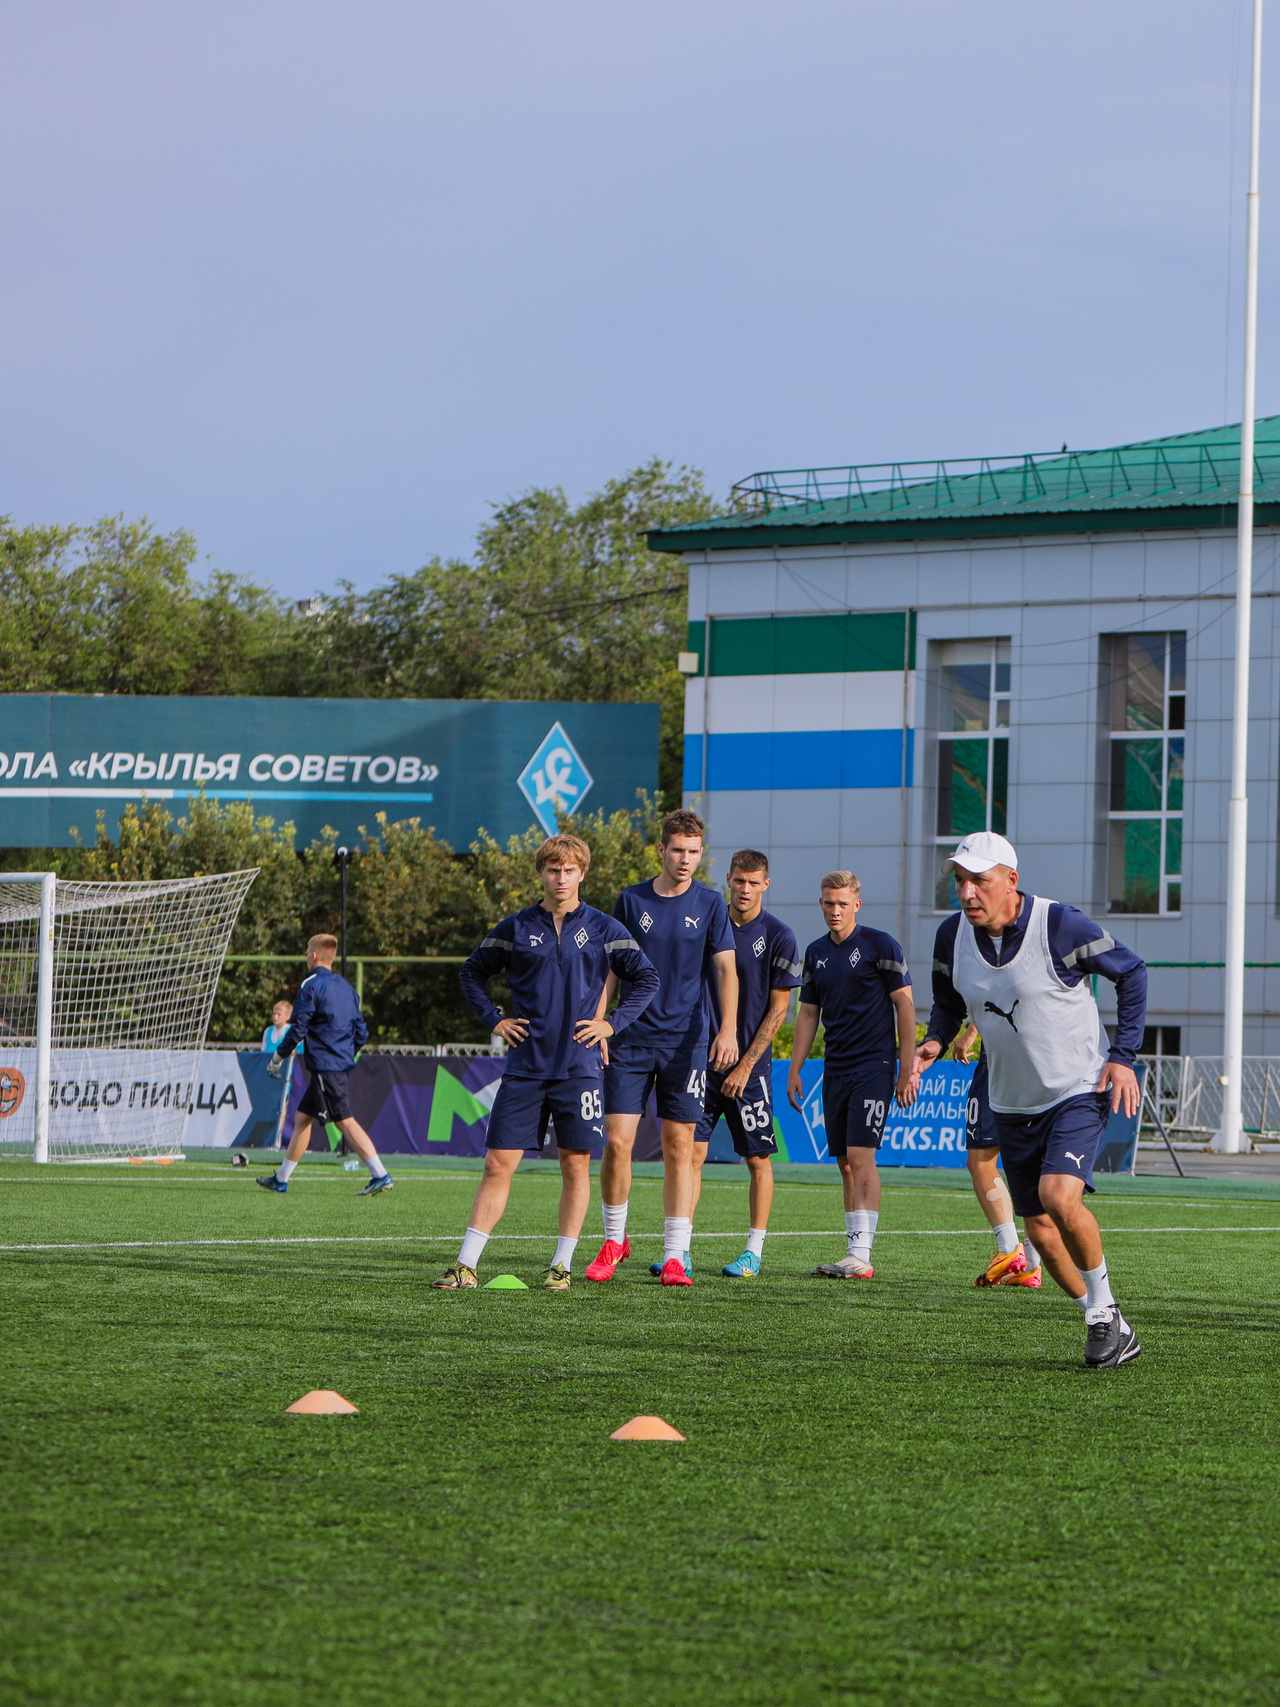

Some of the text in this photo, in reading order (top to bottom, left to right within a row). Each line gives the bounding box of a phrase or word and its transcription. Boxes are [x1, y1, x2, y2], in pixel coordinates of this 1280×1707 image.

[68, 752, 240, 780] «КРЫЛЬЯ
[248, 754, 440, 784] СОВЕТОВ»
[128, 1081, 239, 1115] ПИЦЦА
[580, 1089, 604, 1121] 85
[863, 1099, 885, 1128] 79
[740, 1101, 770, 1132] 63
